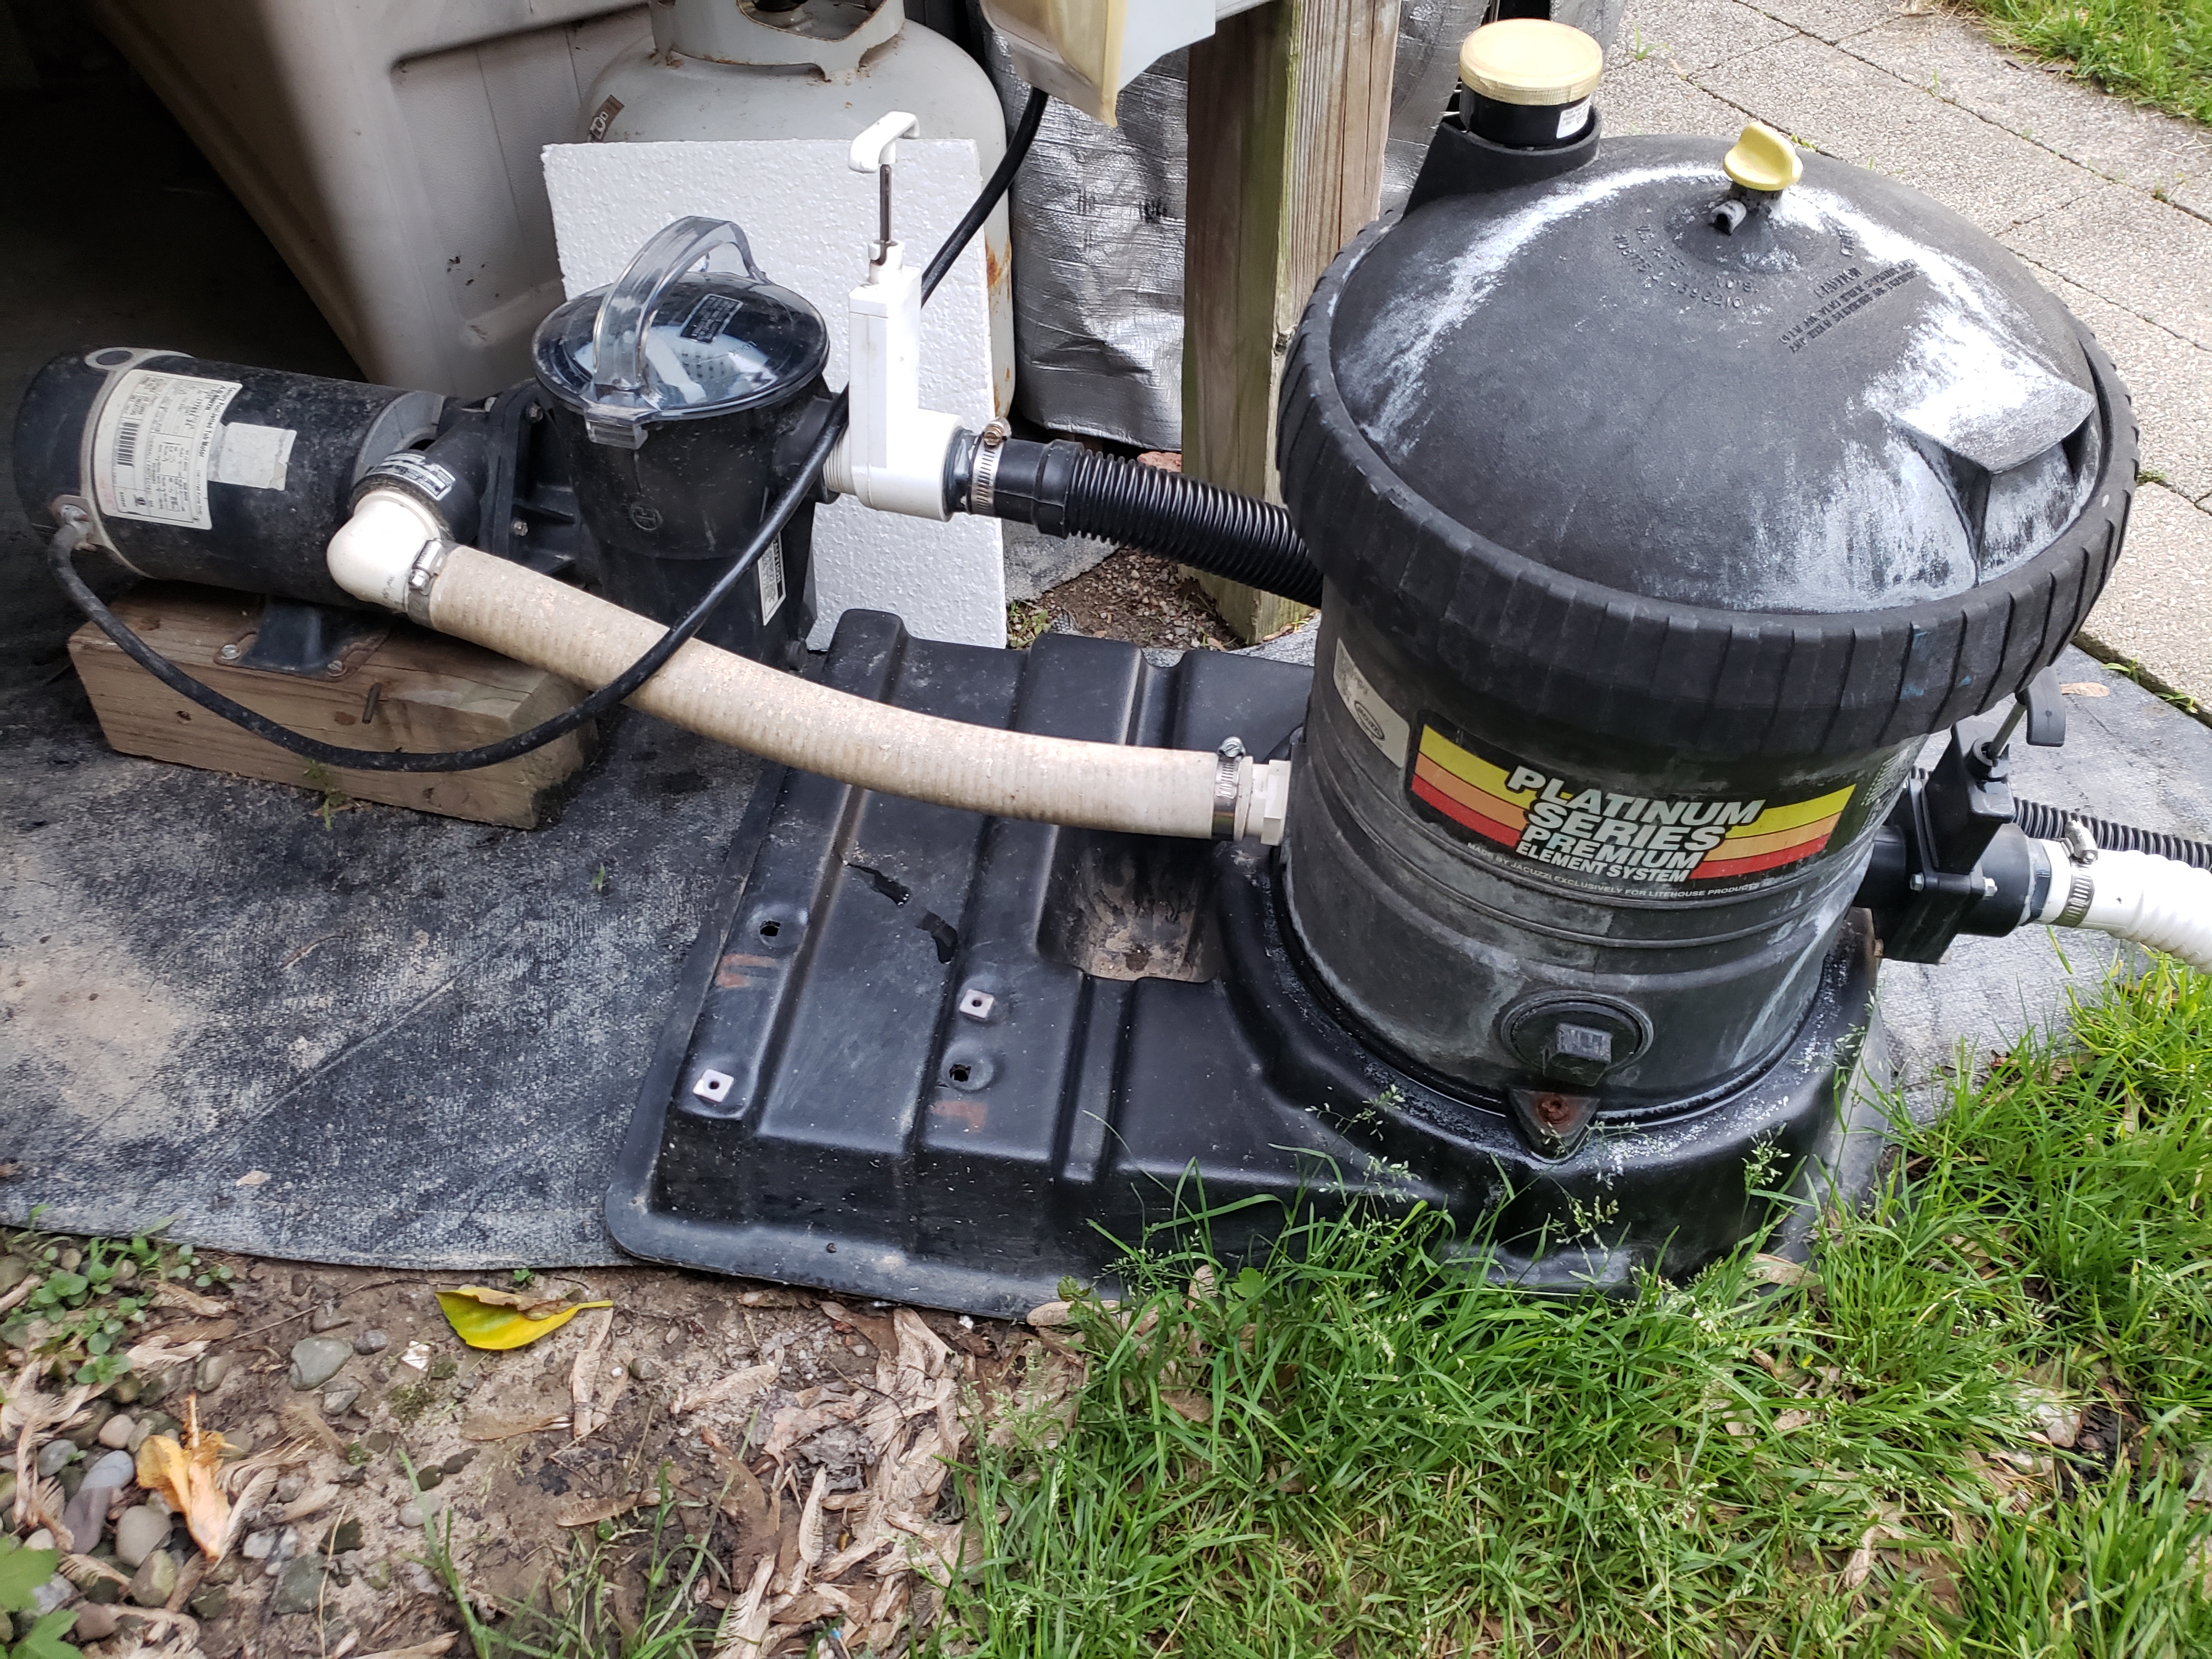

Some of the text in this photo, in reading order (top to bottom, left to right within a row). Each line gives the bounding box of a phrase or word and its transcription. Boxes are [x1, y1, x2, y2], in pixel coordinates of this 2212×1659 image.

[198, 441, 207, 457] Motor
[1507, 766, 1766, 826] PLATINUM
[1522, 825, 1705, 869] PREMIUM
[1528, 802, 1726, 851] SERIES
[1467, 842, 1760, 898] MADE BY JACUZZI EXCLUSIVELY FOR LITEHOUSE PRODUCTS
[1516, 842, 1690, 883] ELEMENT SYSTEM
